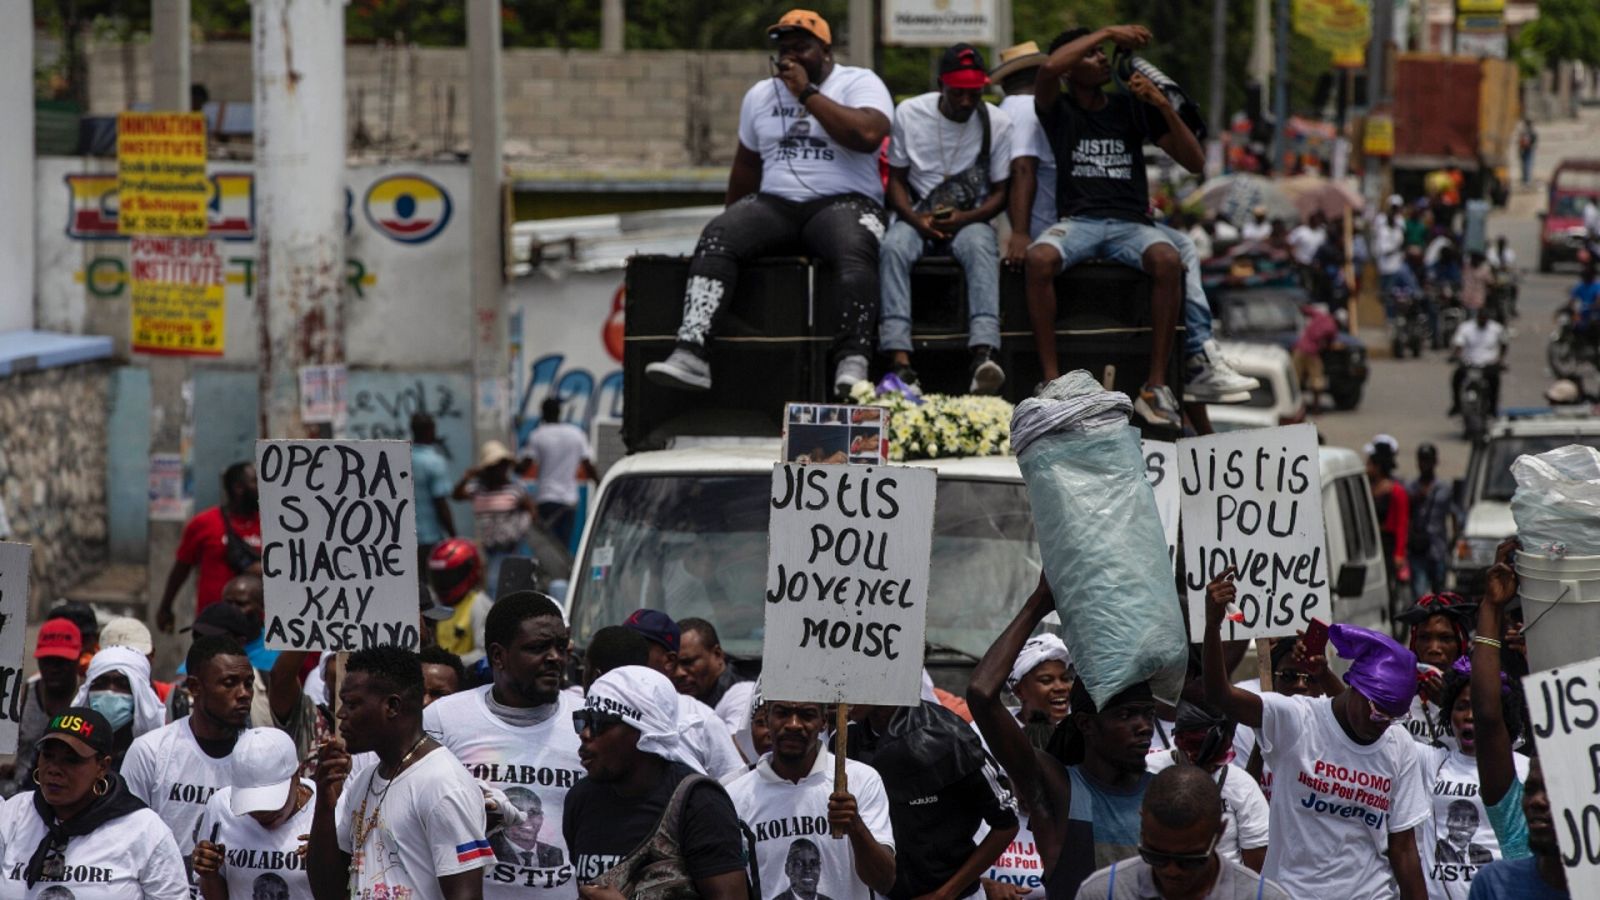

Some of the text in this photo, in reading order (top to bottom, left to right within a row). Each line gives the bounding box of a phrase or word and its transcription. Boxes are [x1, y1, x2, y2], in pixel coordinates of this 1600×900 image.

[1076, 139, 1126, 155] JISTIS
[278, 495, 408, 546] SYON
[1216, 494, 1298, 542] POU
[263, 538, 405, 582] CHACHE
[808, 523, 889, 571] POU
[299, 585, 375, 624] KAY
[52, 716, 94, 737] KUSH
[1314, 759, 1391, 794] PROJOMO
[1331, 783, 1355, 801] Pou
[1301, 792, 1384, 830] Jovenel
[1014, 856, 1038, 869] Pou
